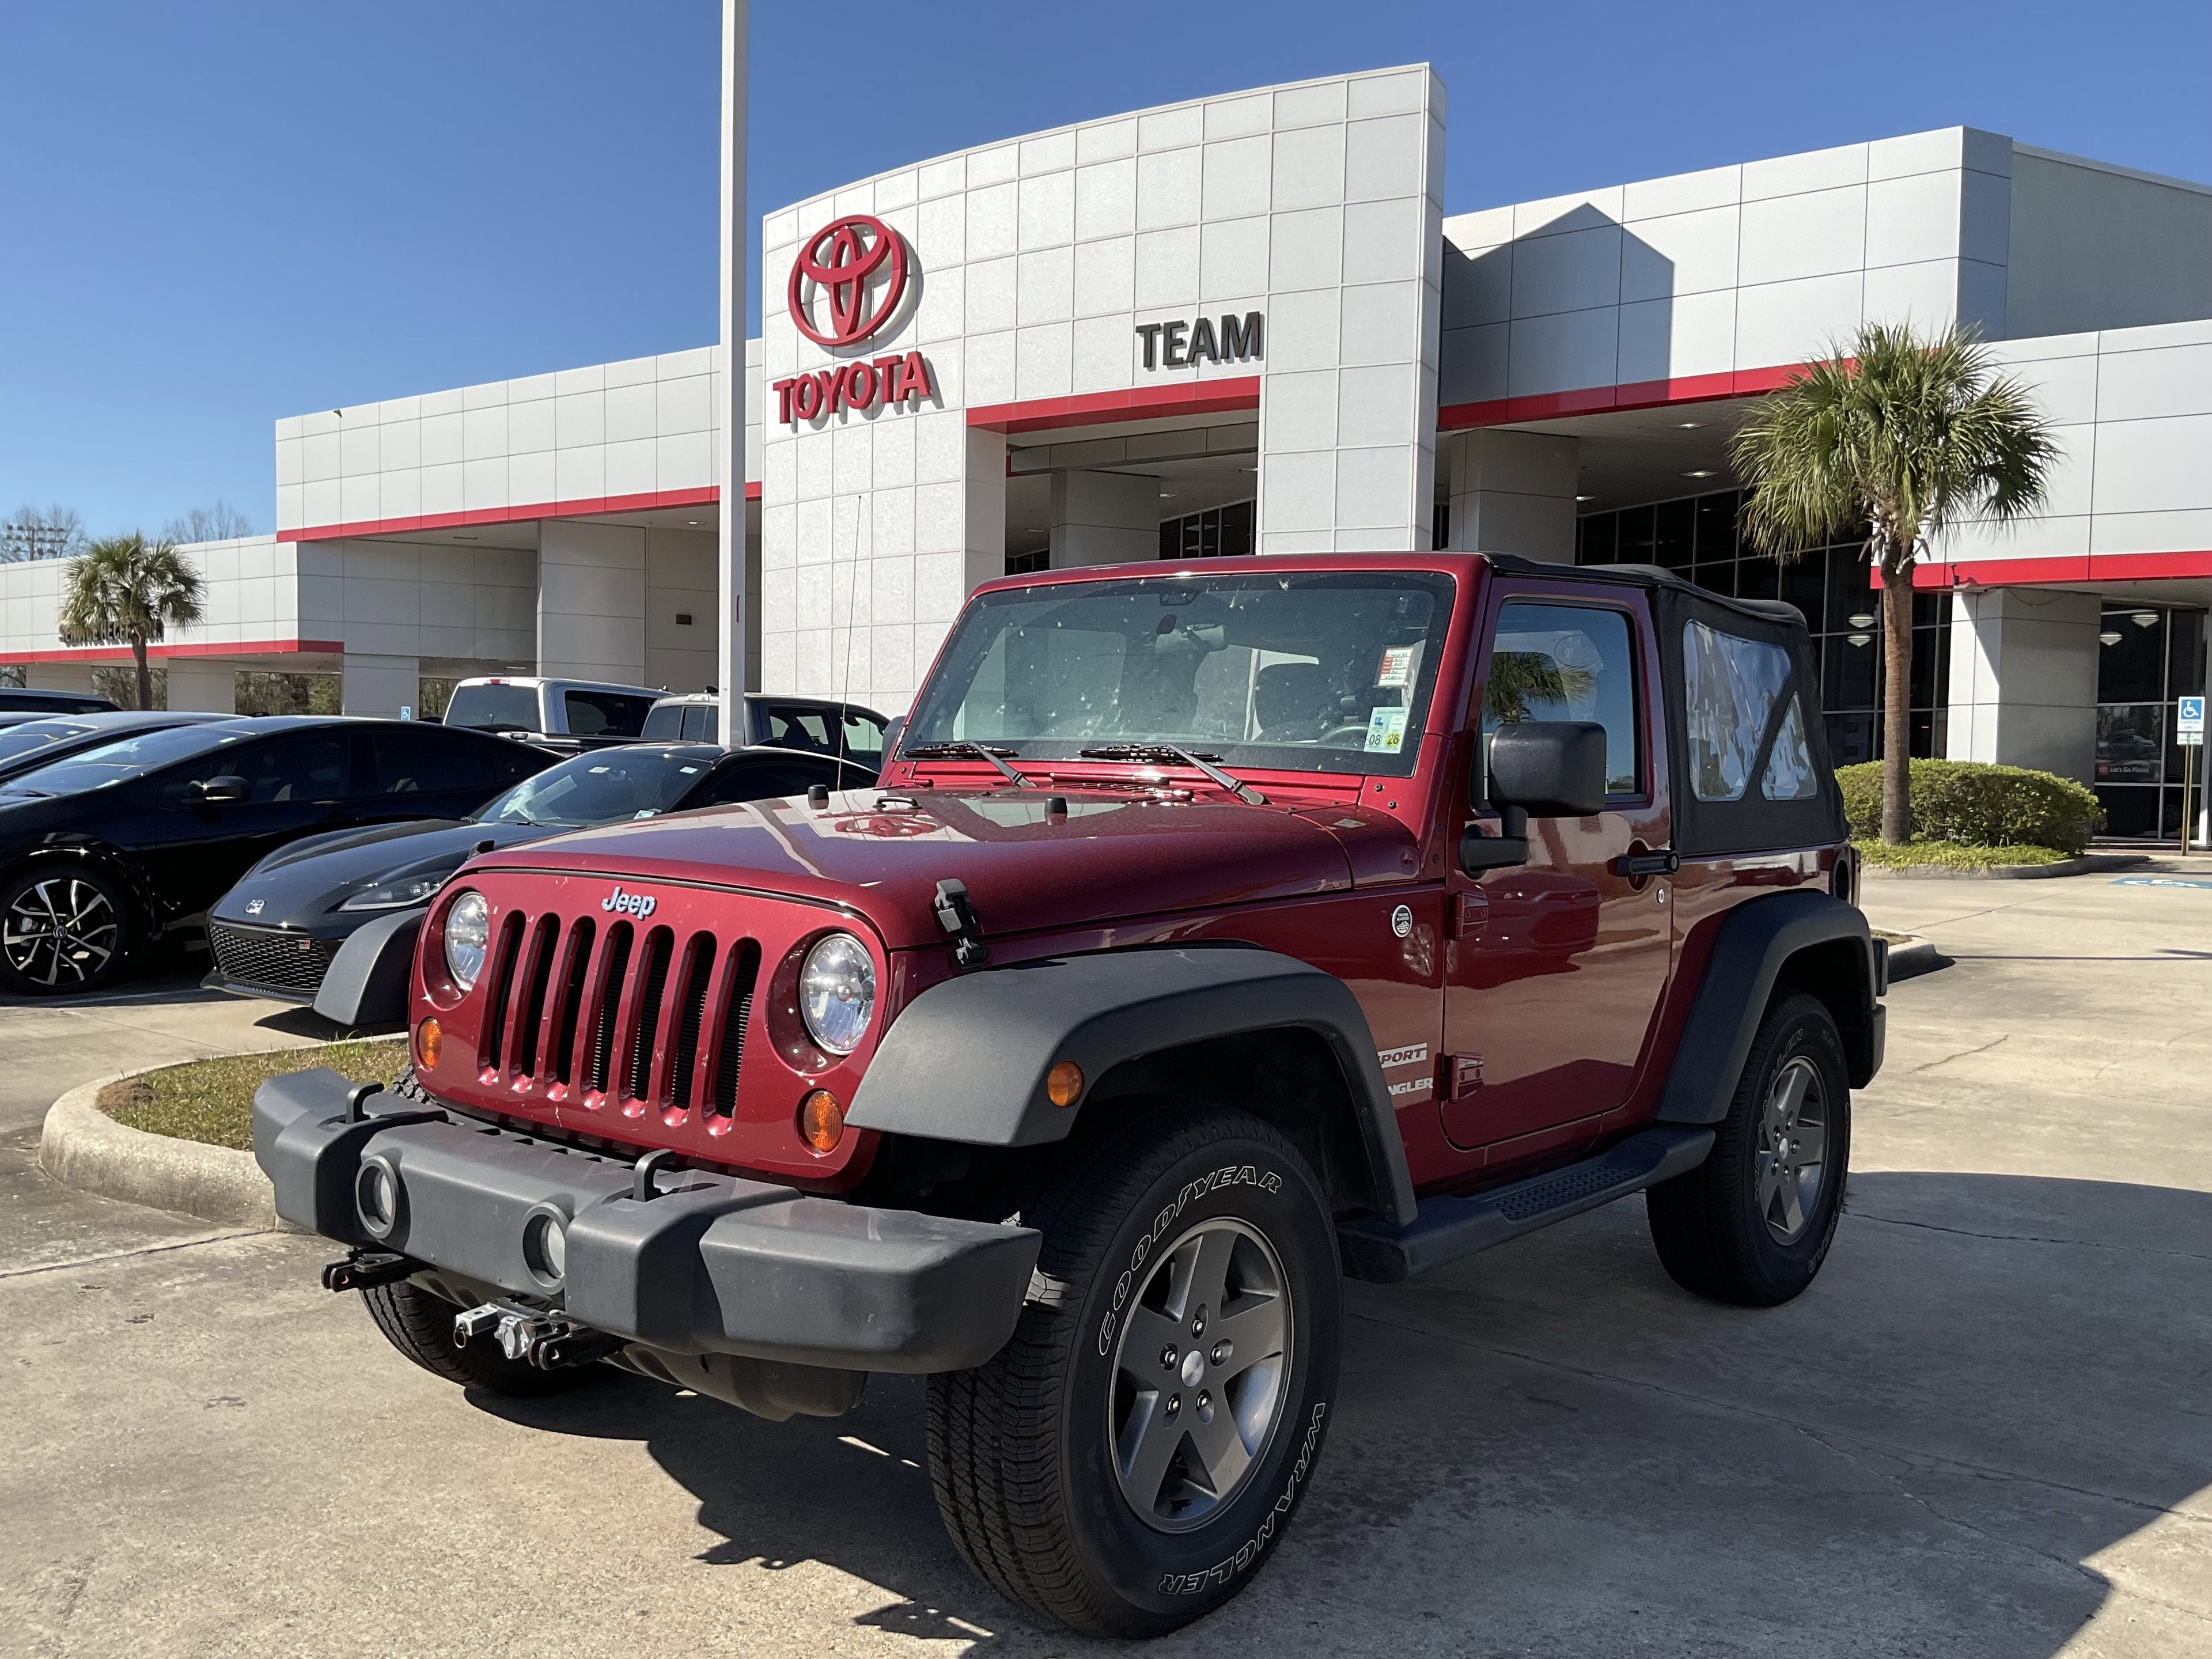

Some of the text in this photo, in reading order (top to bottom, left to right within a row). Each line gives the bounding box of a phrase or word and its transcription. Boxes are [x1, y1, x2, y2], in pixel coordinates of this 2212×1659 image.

[1135, 311, 1260, 368] TEAM
[772, 351, 931, 425] TOYOTA
[1369, 734, 1400, 745] 08 26
[601, 887, 656, 921] Jeep
[1378, 1048, 1427, 1065] PORT
[1387, 1077, 1433, 1096] NGLER
[1099, 1165, 1282, 1356] GOODYEAR
[1158, 1403, 1325, 1594] WRANGLER
